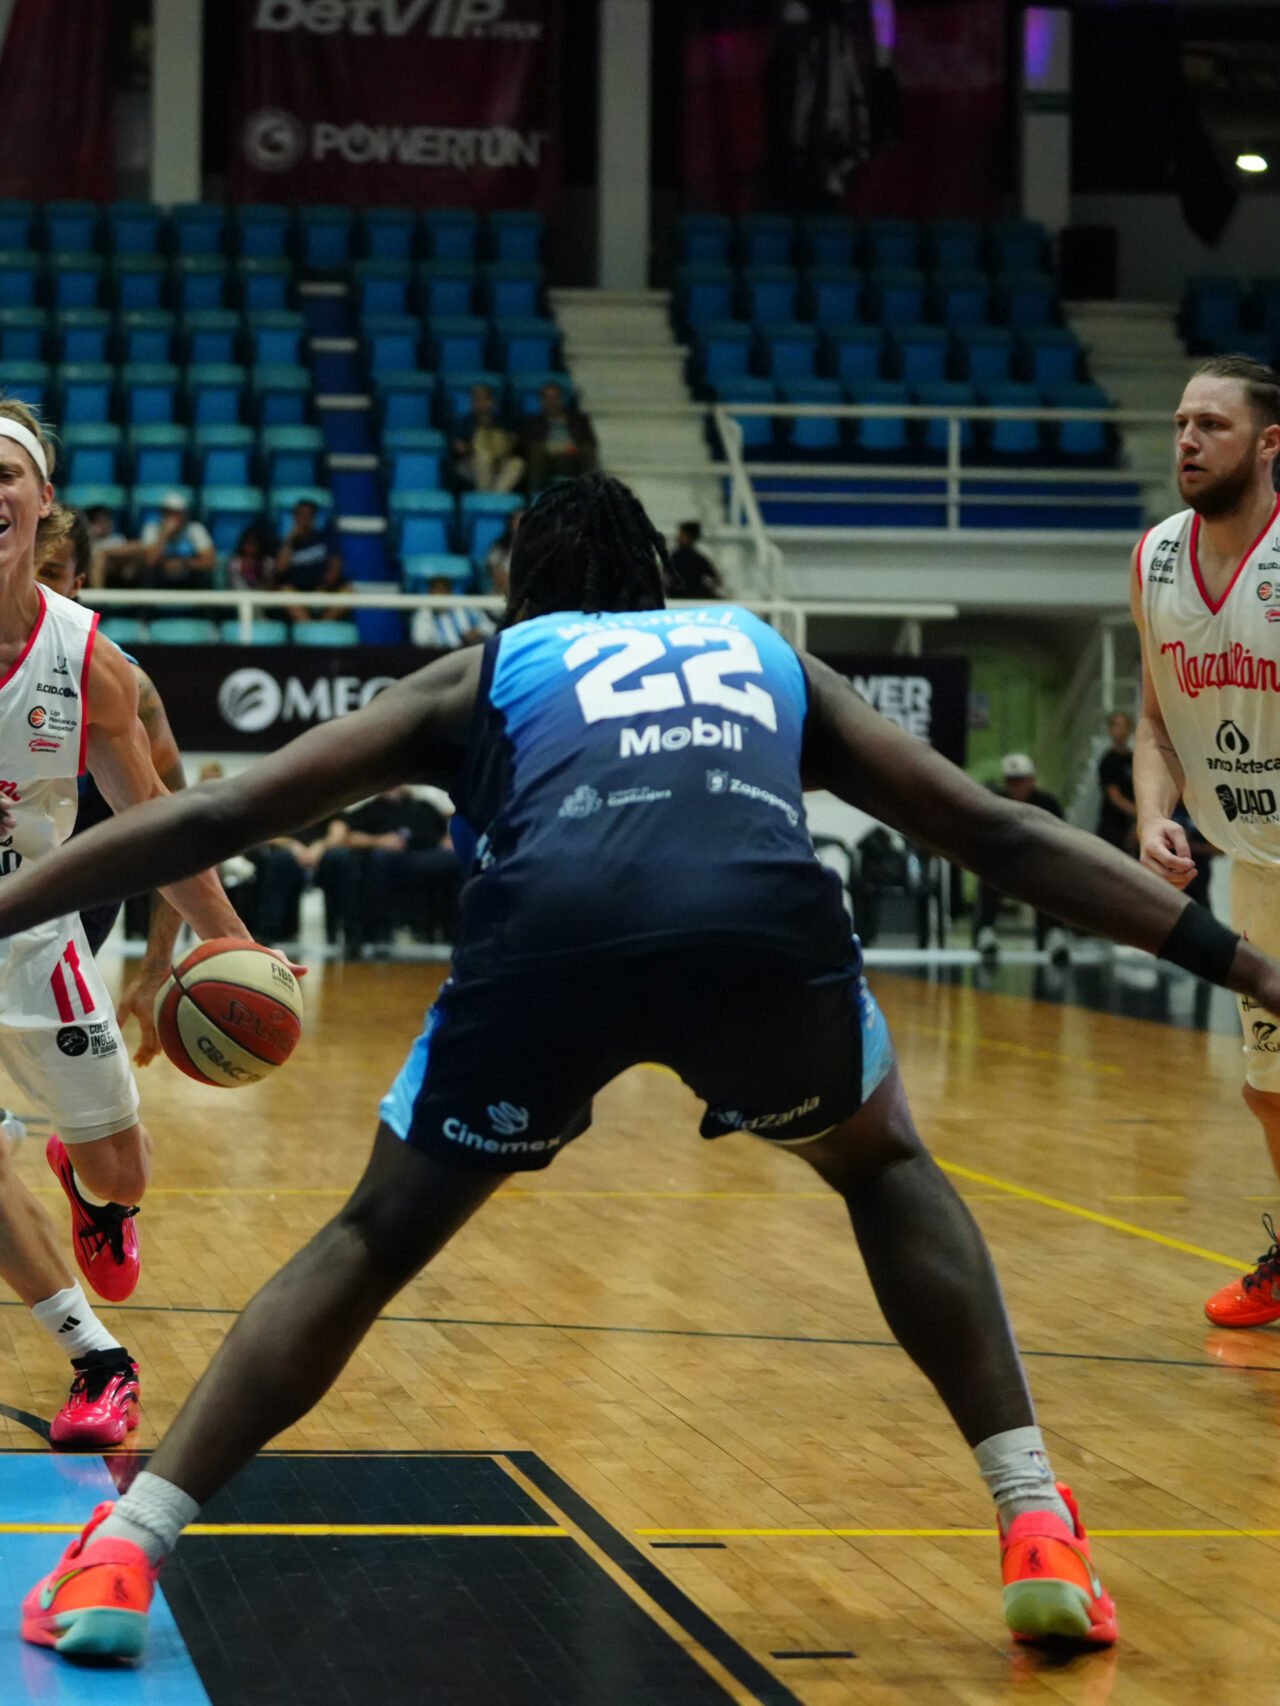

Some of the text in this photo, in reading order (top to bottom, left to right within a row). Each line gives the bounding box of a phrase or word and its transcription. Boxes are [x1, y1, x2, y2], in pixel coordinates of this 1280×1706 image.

[563, 625, 778, 734] 22
[620, 716, 743, 758] Mobil
[1235, 787, 1277, 816] UAD
[271, 963, 294, 985] FIBA
[442, 1117, 562, 1153] Cinemex
